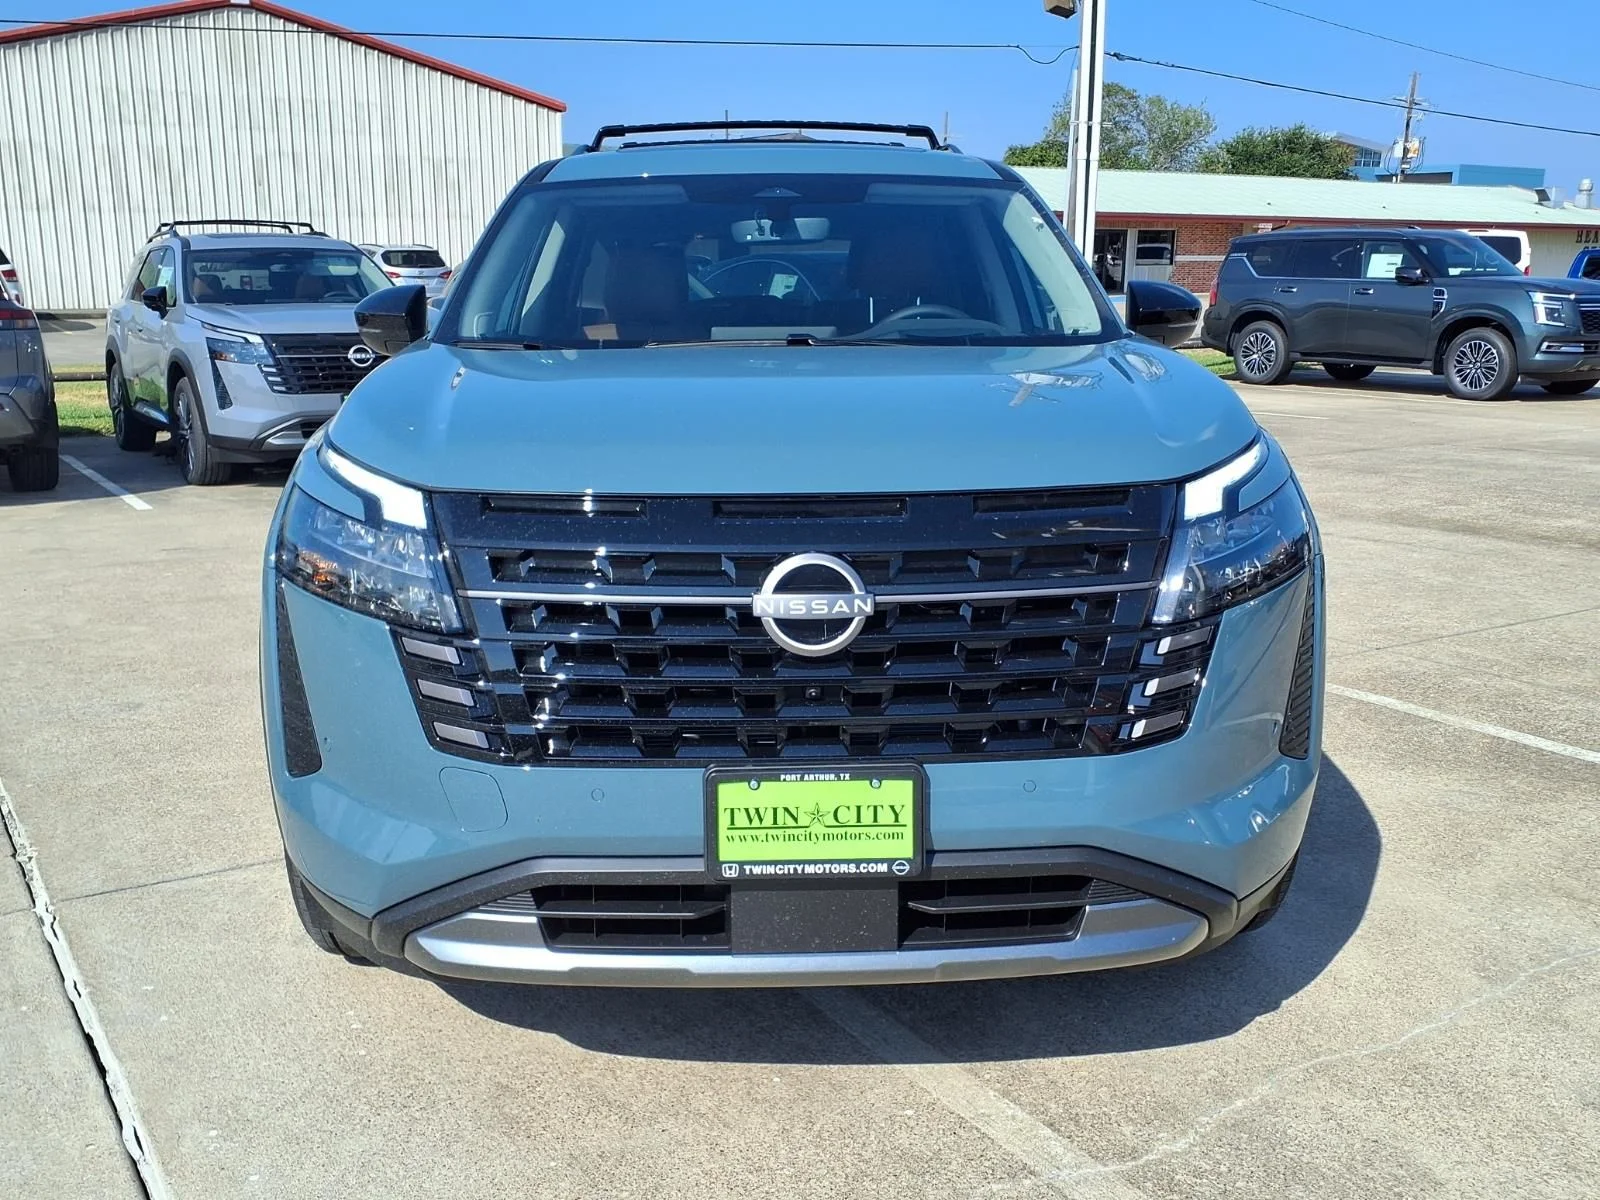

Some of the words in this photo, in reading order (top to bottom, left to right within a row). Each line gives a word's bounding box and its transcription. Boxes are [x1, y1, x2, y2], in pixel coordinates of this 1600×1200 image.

[756, 598, 872, 615] NISSAN
[780, 773, 801, 781] PORT
[803, 773, 838, 781] ARTHUR,
[840, 773, 851, 781] TX
[724, 806, 799, 826] TWIN
[833, 804, 905, 824] CITY
[726, 830, 905, 844] www.twincitymotors.com
[743, 862, 888, 875] TWINCITYMOTORS.COM
